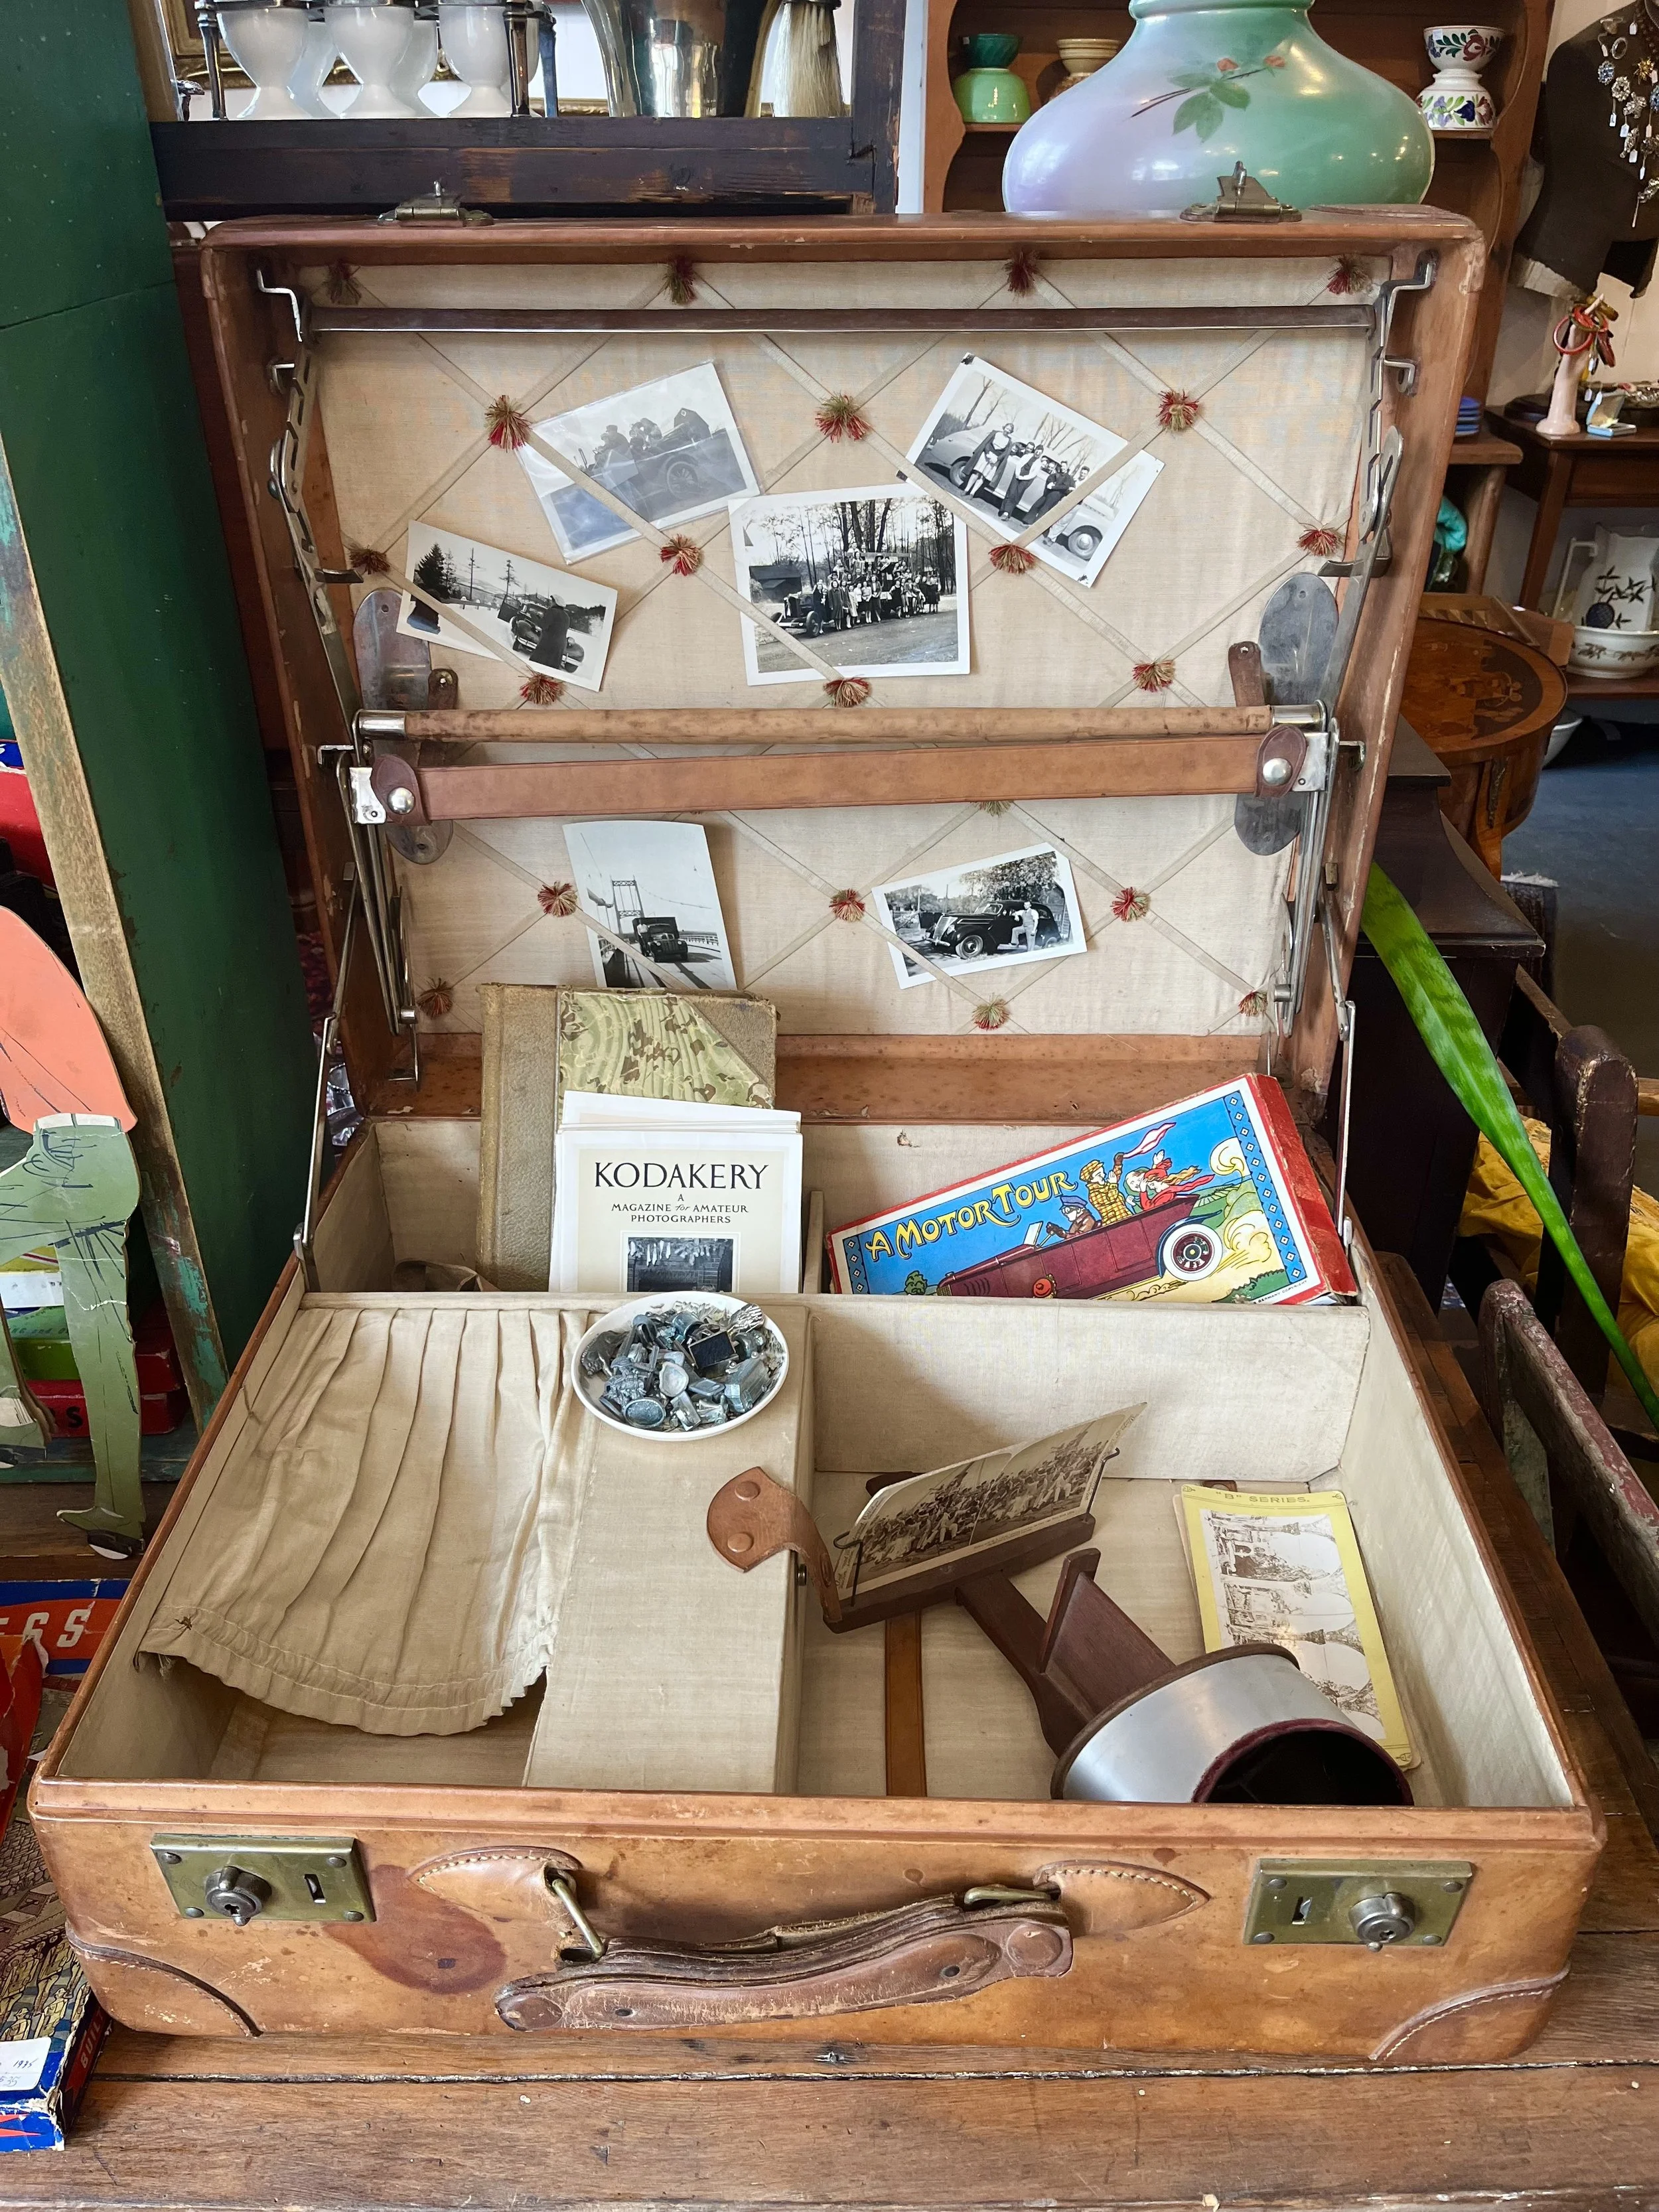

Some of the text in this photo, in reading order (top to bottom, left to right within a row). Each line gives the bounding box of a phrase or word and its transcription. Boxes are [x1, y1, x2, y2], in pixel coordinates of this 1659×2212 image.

[595, 1161, 769, 1190] KODAKERY
[677, 1193, 684, 1202] A
[611, 1203, 672, 1213] MAGAZINE
[693, 1205, 749, 1213] AMATEUR
[631, 1215, 731, 1224] PHOTOGRAPHERS
[865, 1170, 1078, 1262] A MOTOR TOUR
[1249, 1495, 1310, 1504] SERIES.
